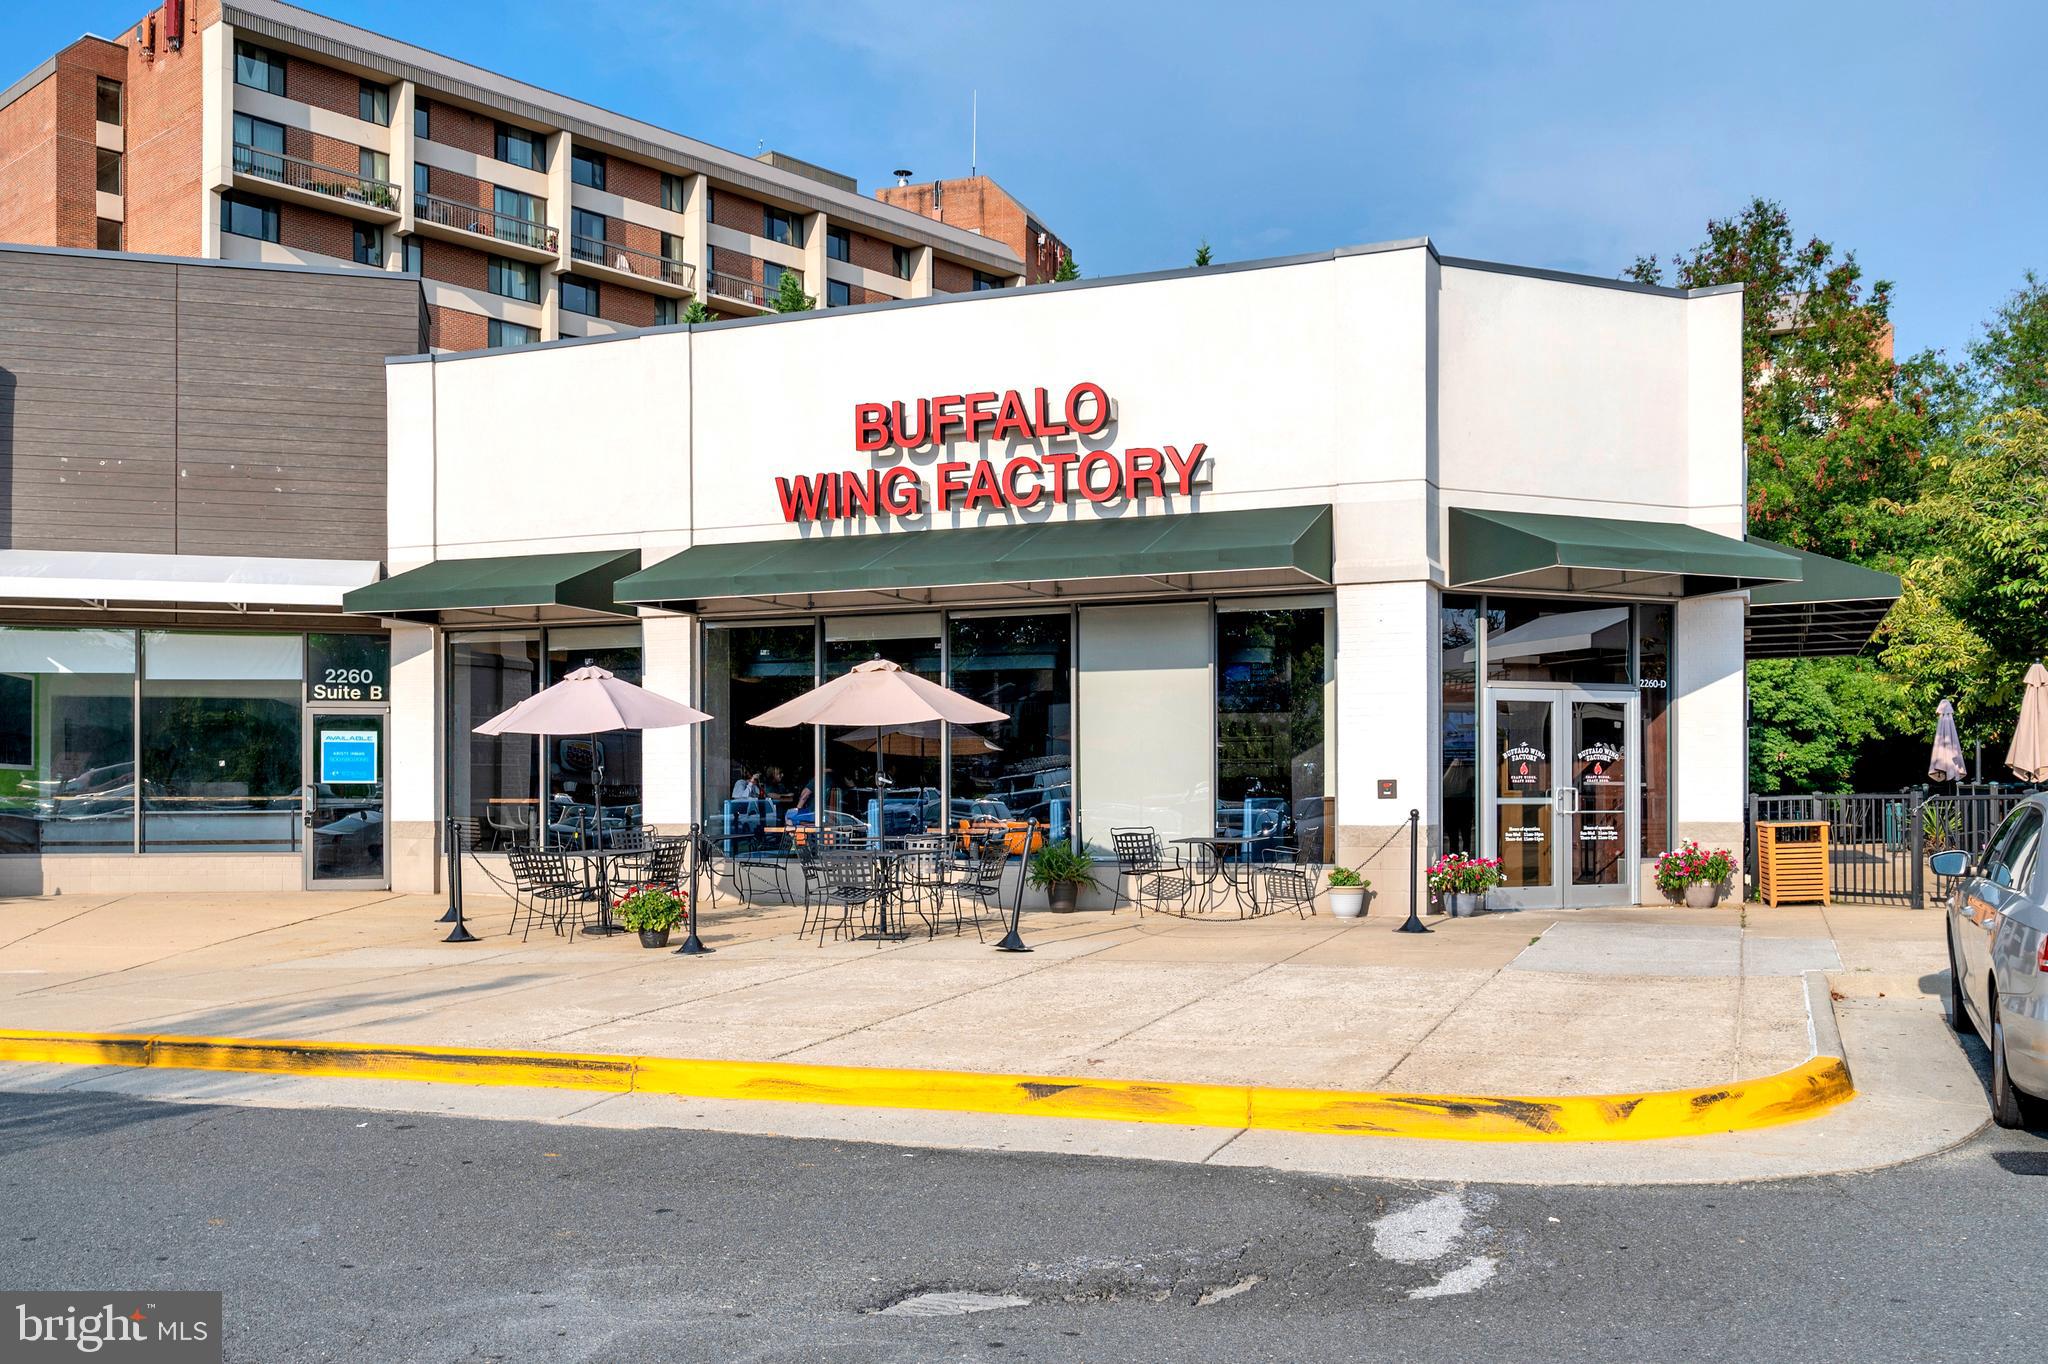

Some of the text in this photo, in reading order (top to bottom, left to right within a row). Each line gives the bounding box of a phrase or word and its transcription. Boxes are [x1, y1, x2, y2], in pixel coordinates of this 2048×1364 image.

[855, 382, 1111, 452] BUFFALO
[775, 443, 1208, 522] WING FACTORY
[325, 669, 373, 684] 2260
[1640, 679, 1666, 688] 2260-D
[313, 684, 383, 700] Suite B
[1502, 747, 1546, 760] BUFFALO WING
[1511, 753, 1537, 762] FACTORY
[1577, 748, 1619, 760] BUFFALO WING
[1586, 754, 1611, 762] FACTORY
